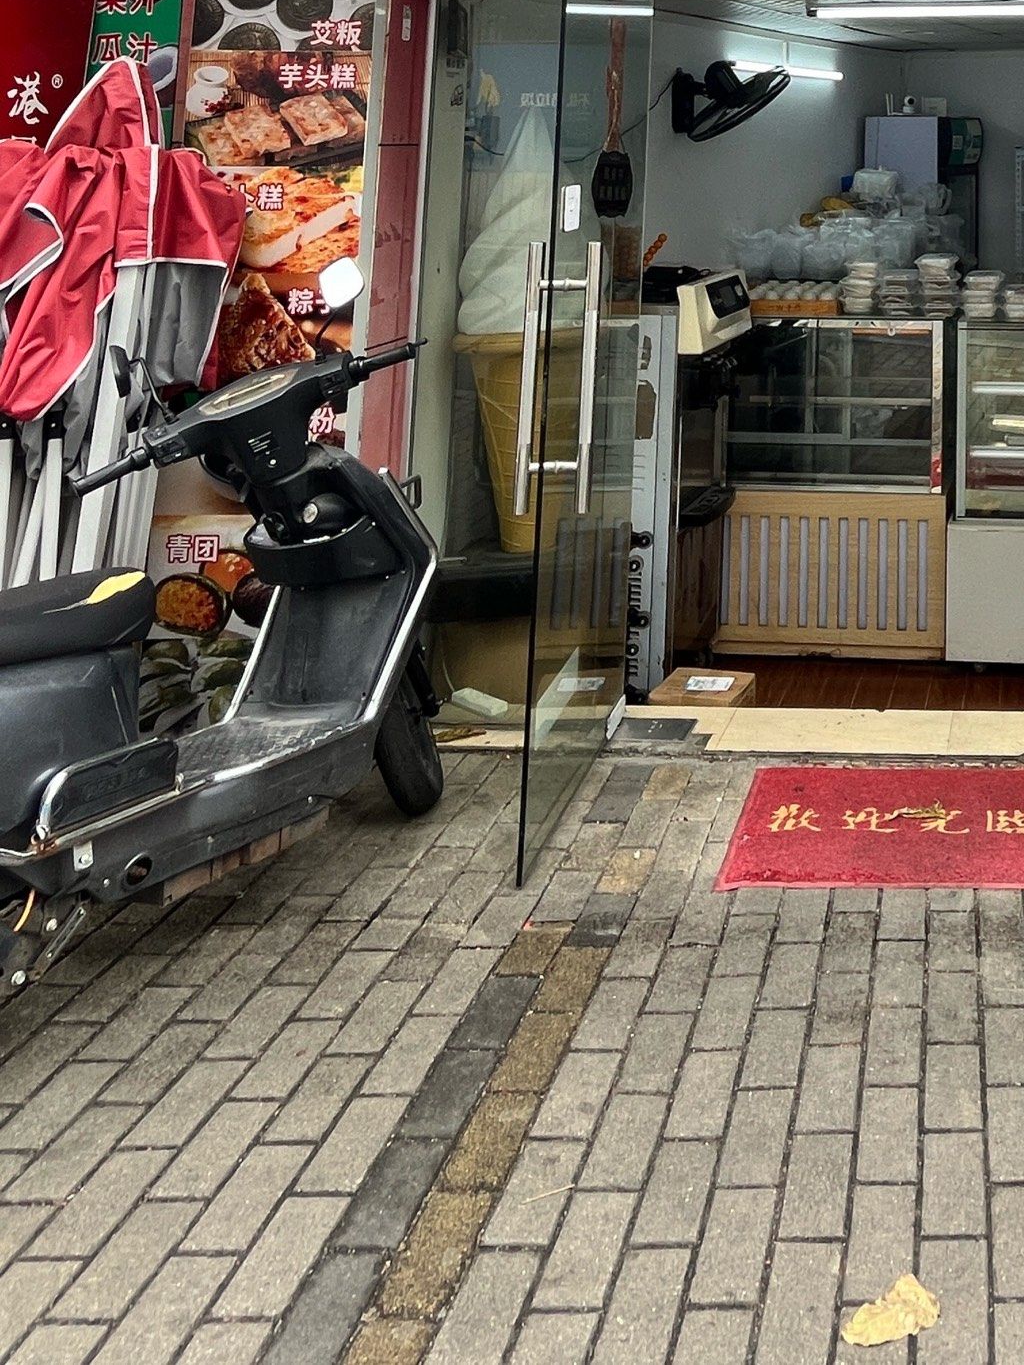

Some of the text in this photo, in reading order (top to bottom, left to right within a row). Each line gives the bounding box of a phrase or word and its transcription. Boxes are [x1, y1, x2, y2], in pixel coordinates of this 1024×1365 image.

[310, 20, 362, 46] 艾粄
[279, 64, 356, 89] 芋头糕
[166, 535, 220, 563] 青团
